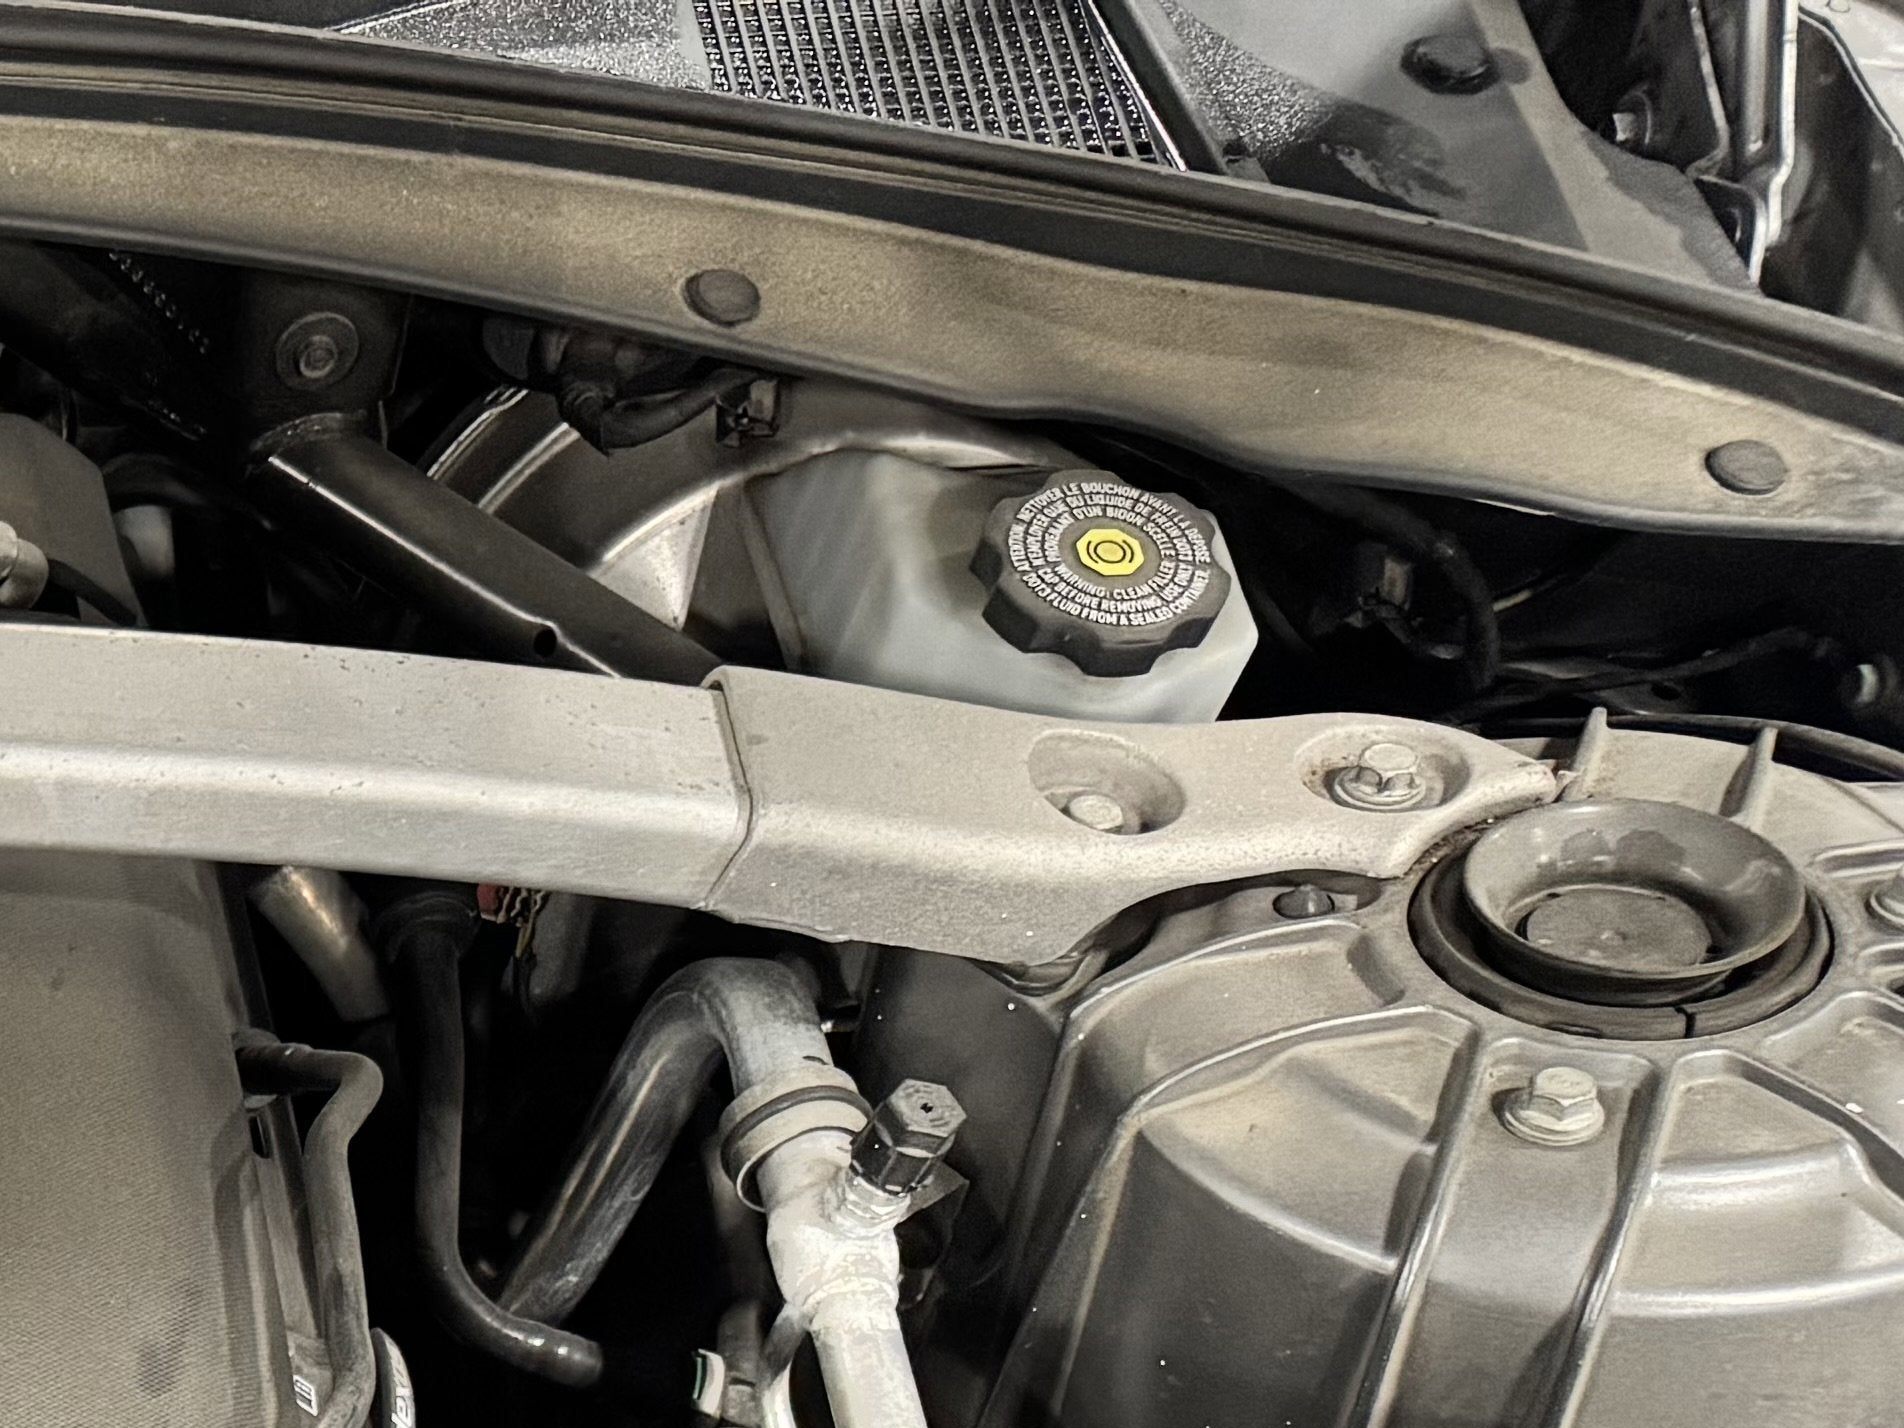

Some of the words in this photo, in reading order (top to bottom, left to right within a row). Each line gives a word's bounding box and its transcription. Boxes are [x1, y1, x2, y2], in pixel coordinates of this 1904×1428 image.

[1017, 487, 1064, 521] NETTOYER
[1062, 483, 1080, 495] LE
[1081, 483, 1142, 499] BOUCHON
[1140, 493, 1175, 520] AVANT
[1174, 514, 1190, 529] LA
[1044, 500, 1068, 517] QUE
[1066, 495, 1084, 506] DU
[1084, 495, 1135, 508] LIQUIDE
[1134, 503, 1149, 515] DE
[1150, 512, 1182, 539] FREIN
[1174, 535, 1193, 561] DOT3
[1044, 513, 1075, 562] PROVENANT
[1073, 506, 1102, 520] D'UN
[1106, 506, 1145, 525] BIDON
[1022, 574, 1049, 597] DOT3
[1047, 594, 1082, 616] FLUID
[1080, 607, 1118, 624] FROM
[1118, 613, 1129, 625] A
[1130, 606, 1173, 626] SEALED
[1037, 568, 1058, 584] CAP
[1056, 582, 1103, 609] BEFORE
[1160, 583, 1183, 601] USE
[1176, 564, 1193, 587] ONLY
[1113, 585, 1153, 600] CLEAN
[1153, 561, 1175, 591] FILLER
